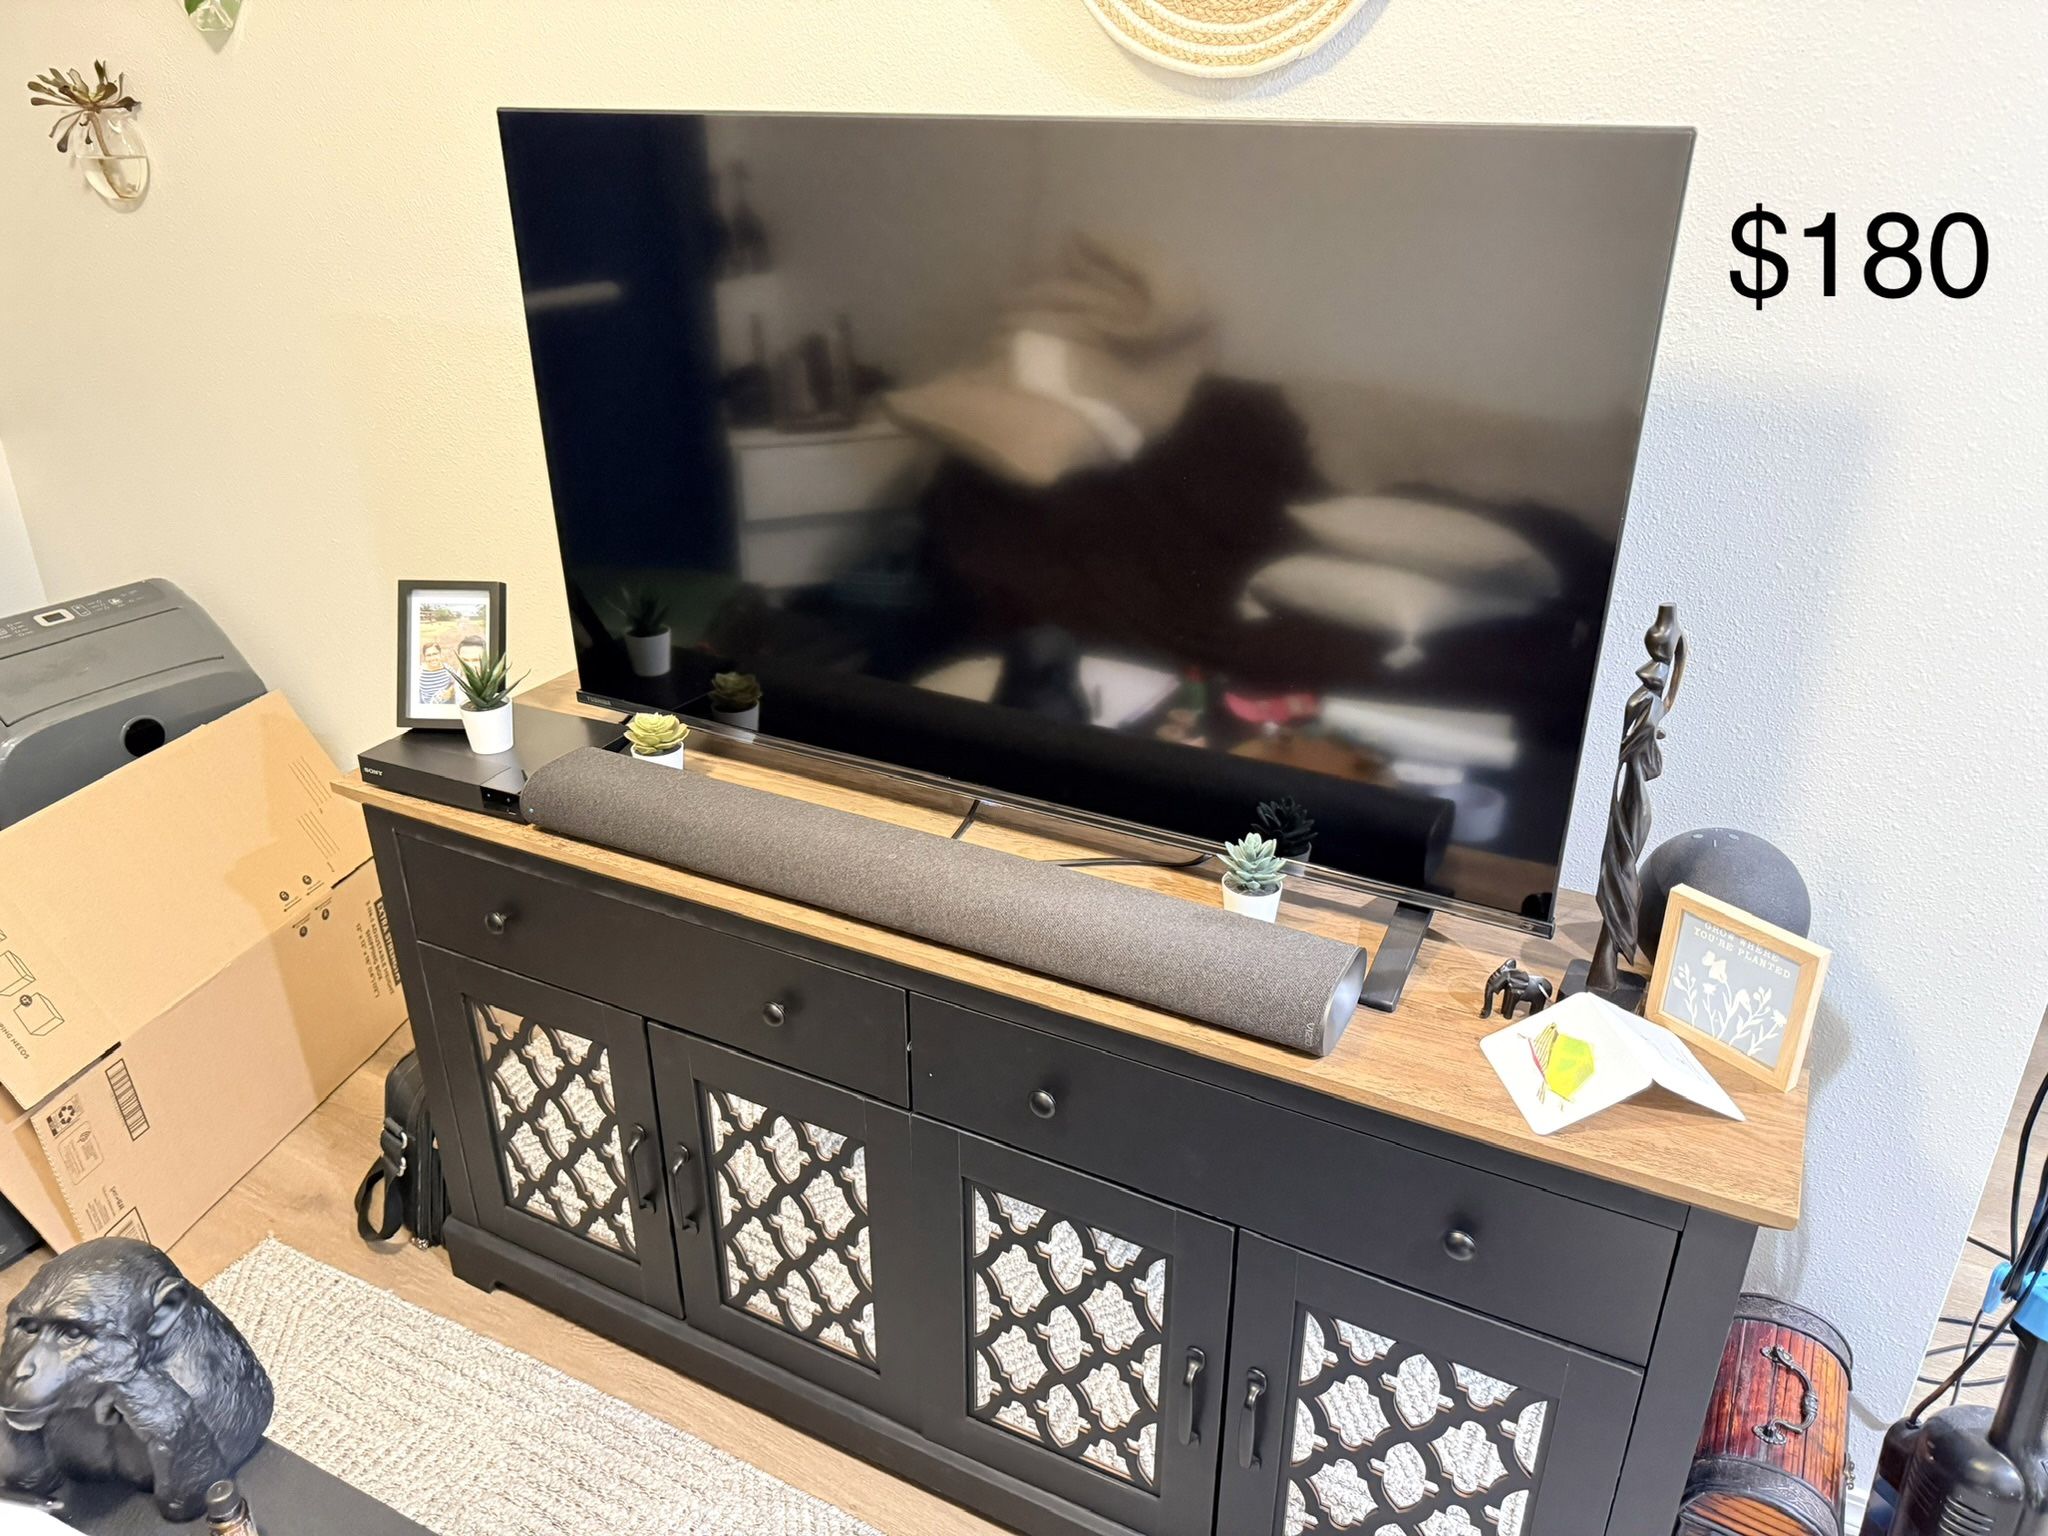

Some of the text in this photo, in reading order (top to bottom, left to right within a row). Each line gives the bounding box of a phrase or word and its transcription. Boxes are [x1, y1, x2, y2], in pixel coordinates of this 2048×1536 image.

[363, 767, 383, 776] SONY
[376, 901, 389, 933] EXTRA
[1693, 926, 1791, 978] YOU'RE PLANTED
[1704, 922, 1779, 962] GROW WHERE
[11, 1038, 30, 1059] NEEDS
[1304, 1022, 1315, 1047] VIZIO
